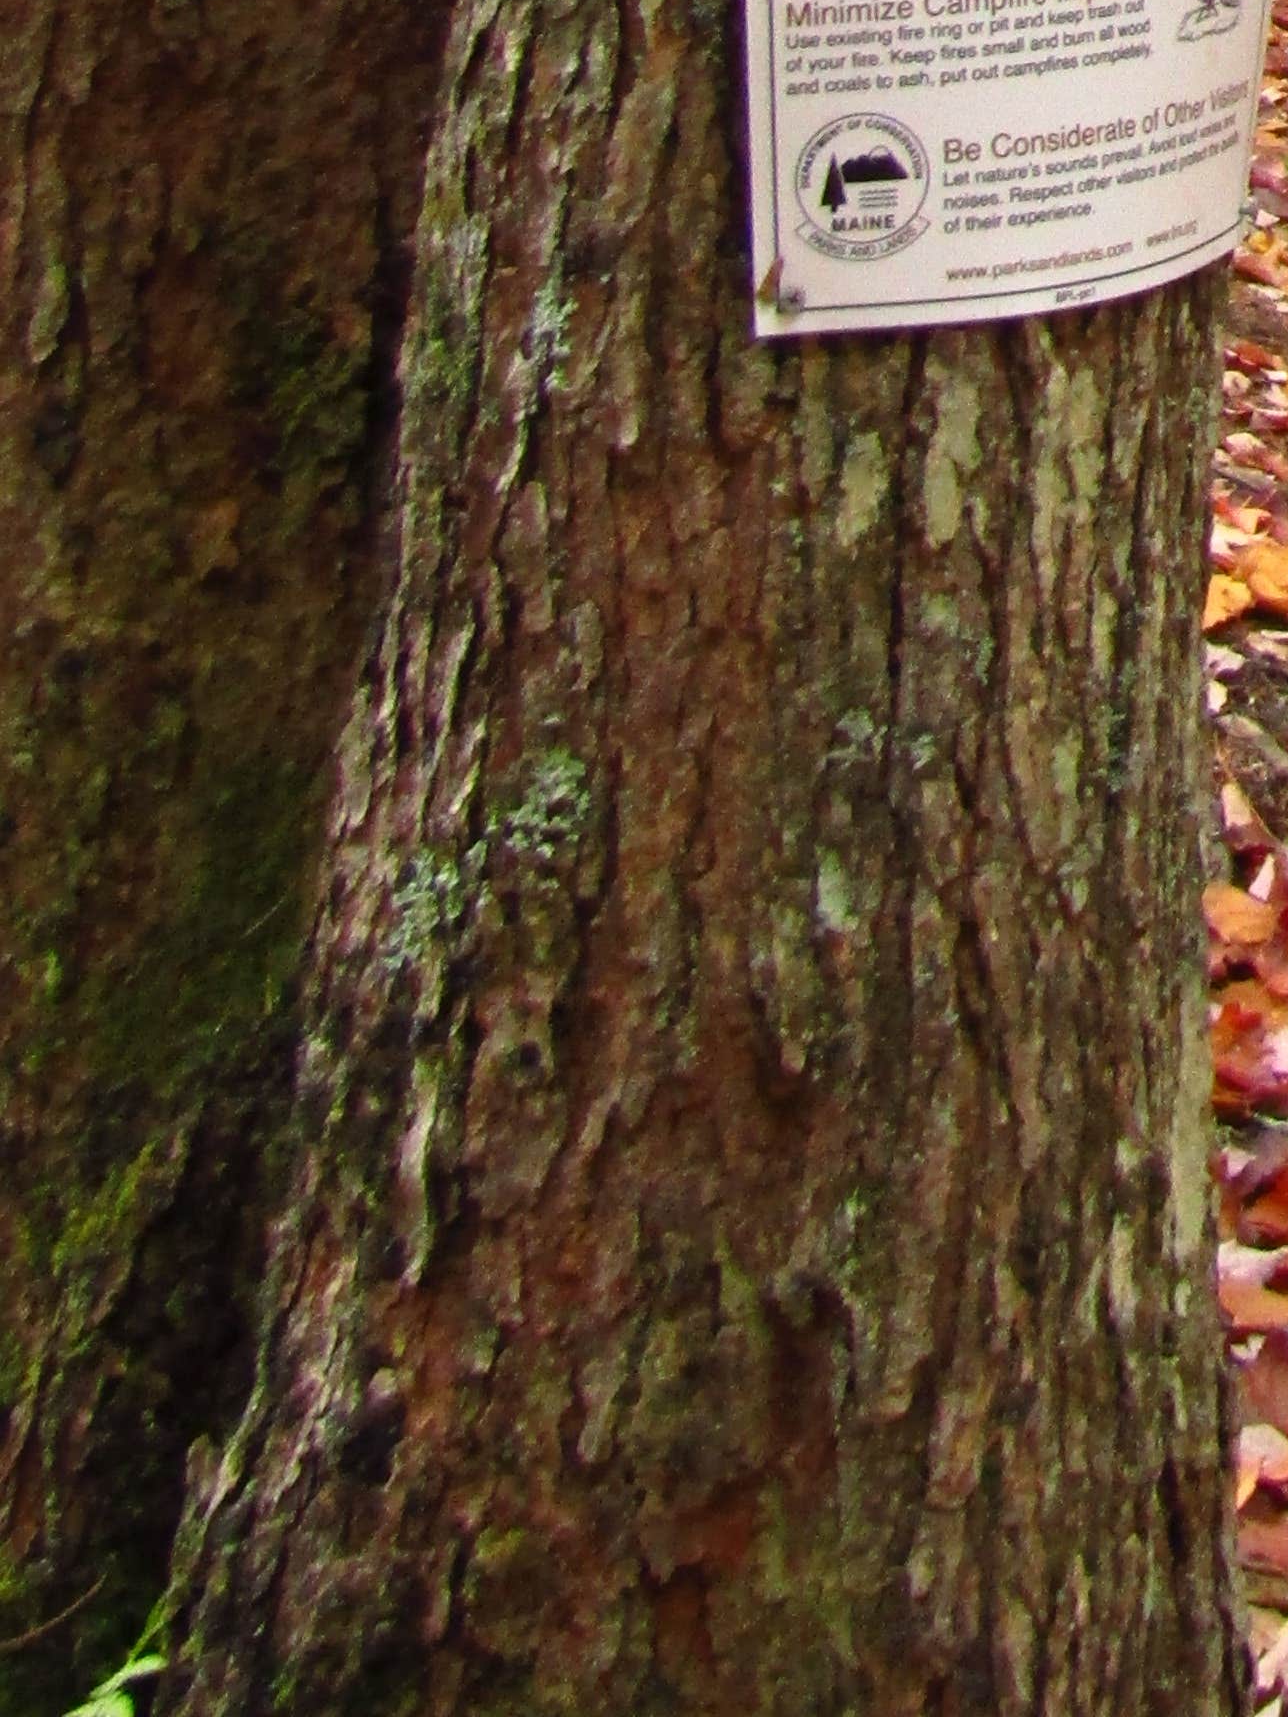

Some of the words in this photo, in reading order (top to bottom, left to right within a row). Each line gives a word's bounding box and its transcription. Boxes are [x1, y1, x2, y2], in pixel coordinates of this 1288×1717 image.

[785, 33, 820, 49] Use
[826, 28, 892, 46] existing
[897, 25, 924, 41] fire
[930, 22, 962, 39] ring
[967, 21, 984, 34] or
[1014, 11, 1043, 29] and
[1047, 9, 1084, 25] keep
[1124, 0, 1144, 15] out
[786, 57, 802, 73] of
[809, 56, 845, 74] your
[889, 48, 936, 64] Keep
[940, 43, 976, 59] fires
[981, 36, 1024, 55] small
[1029, 32, 1058, 50] and
[786, 78, 819, 95] and
[824, 75, 871, 92] coals
[876, 74, 893, 89] to
[940, 67, 966, 87] put
[972, 64, 998, 80] out
[1002, 56, 1078, 77] campfires
[943, 139, 981, 164] Be
[990, 121, 1135, 159] Considerate
[1142, 108, 1160, 135] of
[1164, 99, 1204, 129] Other
[942, 169, 969, 185] Let
[975, 162, 1040, 182] nature's
[1045, 154, 1097, 175] sounds
[1009, 181, 1072, 202] Respect
[1077, 175, 1112, 193] other
[831, 214, 896, 232] MAINE
[943, 216, 959, 232] of
[965, 212, 1002, 230] their
